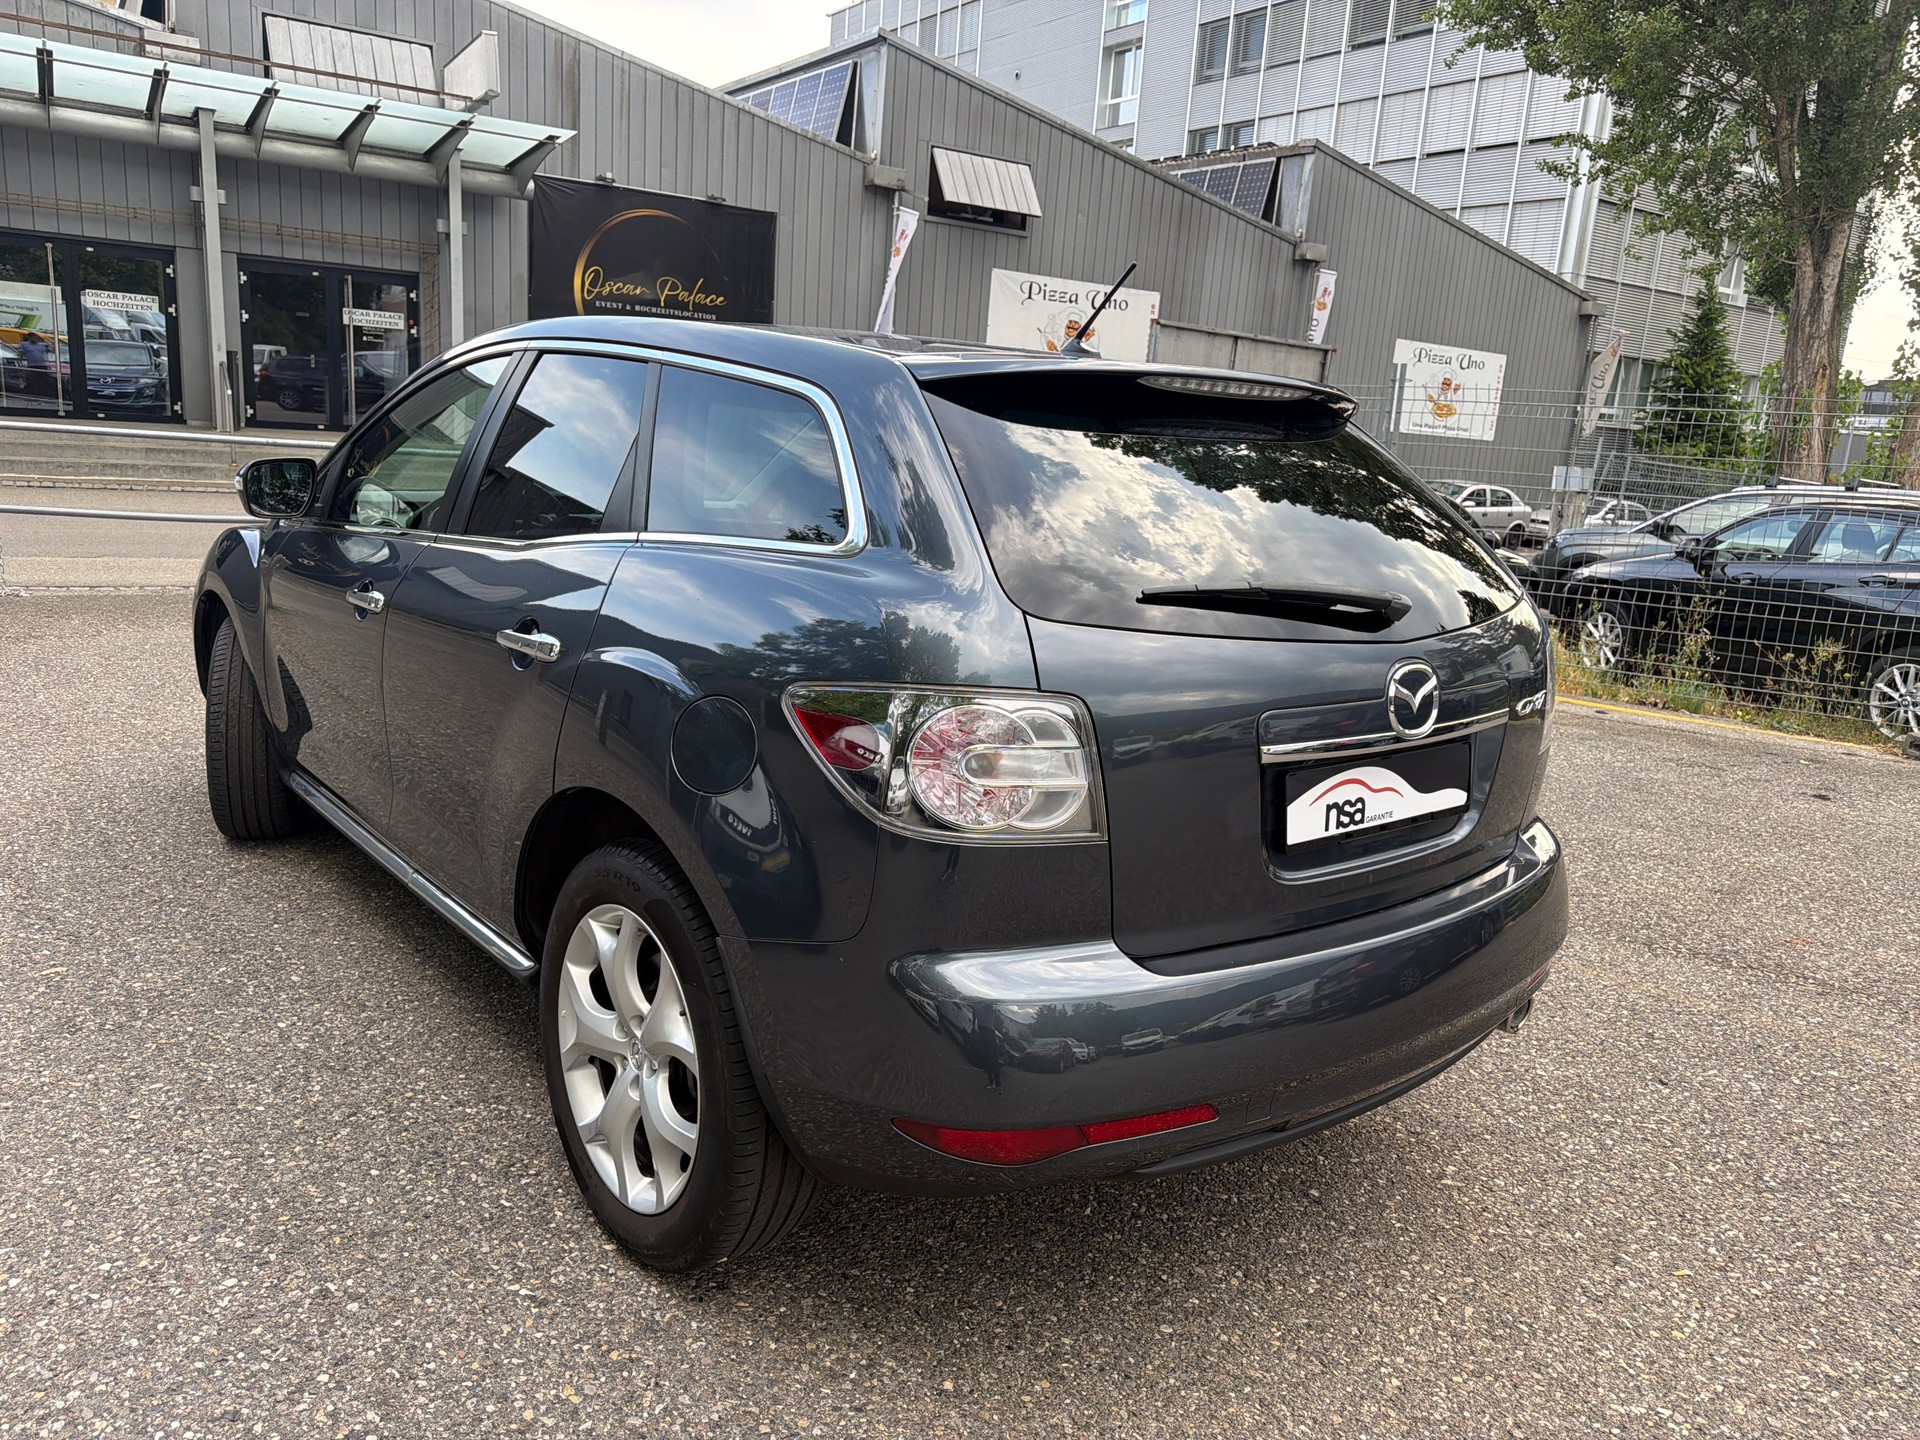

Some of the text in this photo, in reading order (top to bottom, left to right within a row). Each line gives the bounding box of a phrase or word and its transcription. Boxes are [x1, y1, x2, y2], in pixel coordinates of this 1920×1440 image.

[87, 290, 157, 304] OSCAR PALACE
[584, 266, 728, 310] Oscar Palace
[1020, 281, 1079, 306] Pizza
[92, 300, 153, 311] HOCHZEITEN
[373, 312, 403, 320] PALACE
[596, 301, 624, 310] EVENT
[635, 305, 717, 320] HOCHZEITSLOCATION
[1413, 347, 1485, 370] Pizza Uno
[1591, 363, 1610, 389] Uno
[1325, 797, 1394, 832] nsa GARANTIE
